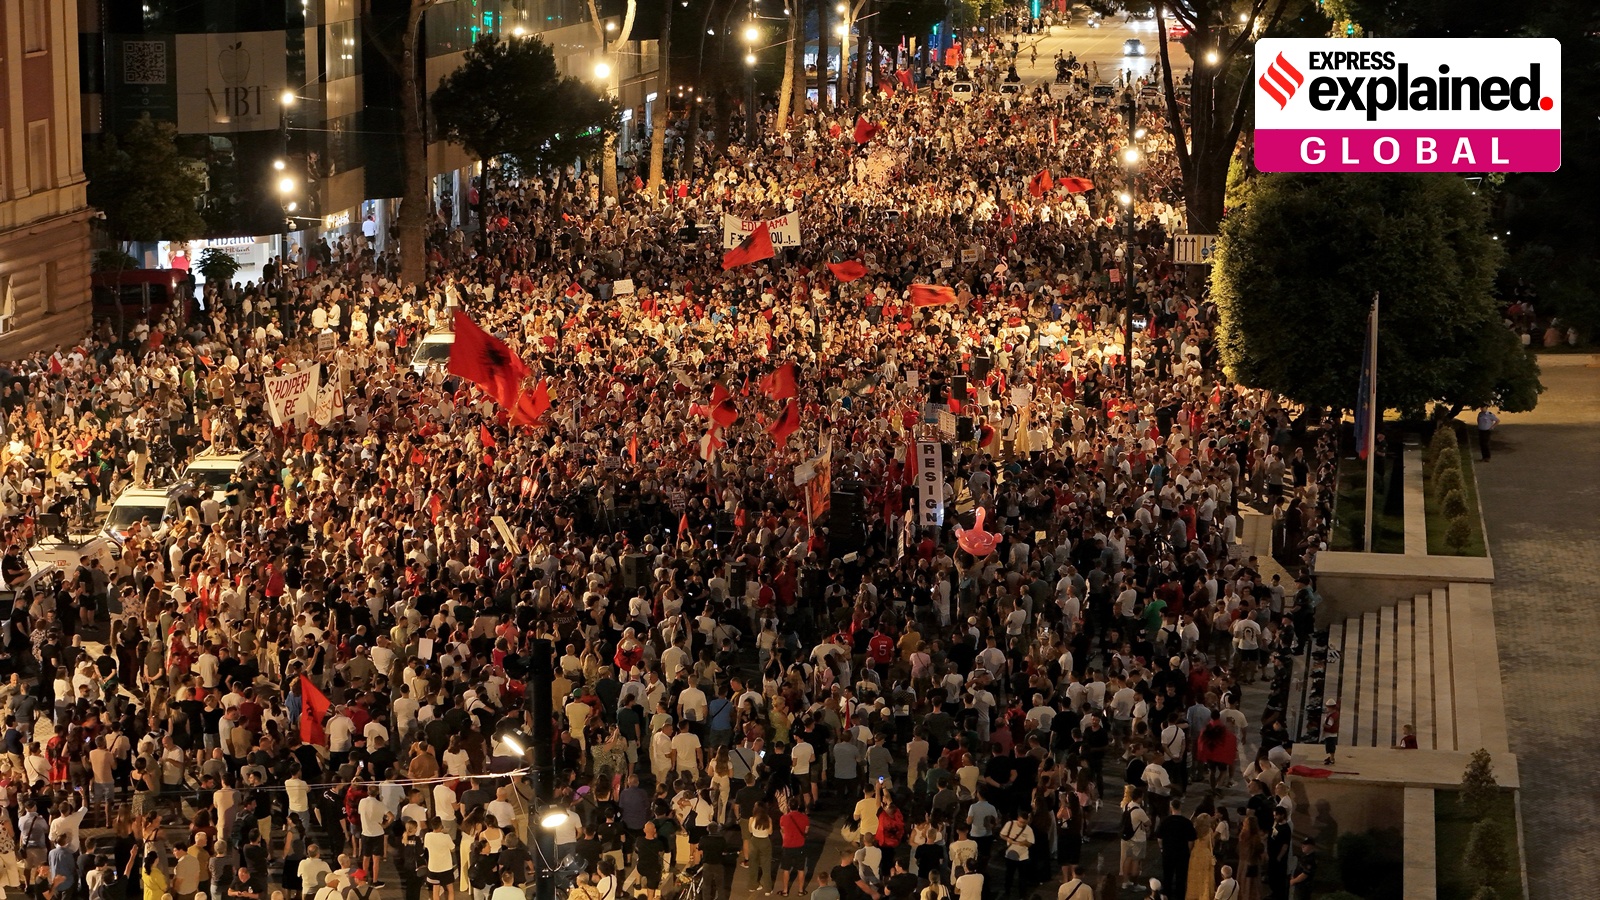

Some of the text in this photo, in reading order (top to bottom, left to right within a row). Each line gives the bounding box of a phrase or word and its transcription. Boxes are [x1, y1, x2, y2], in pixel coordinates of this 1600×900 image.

[204, 85, 268, 117] MBT
[762, 216, 788, 230] AMA
[923, 444, 938, 522] RESIGN
[879, 644, 887, 656] 5
